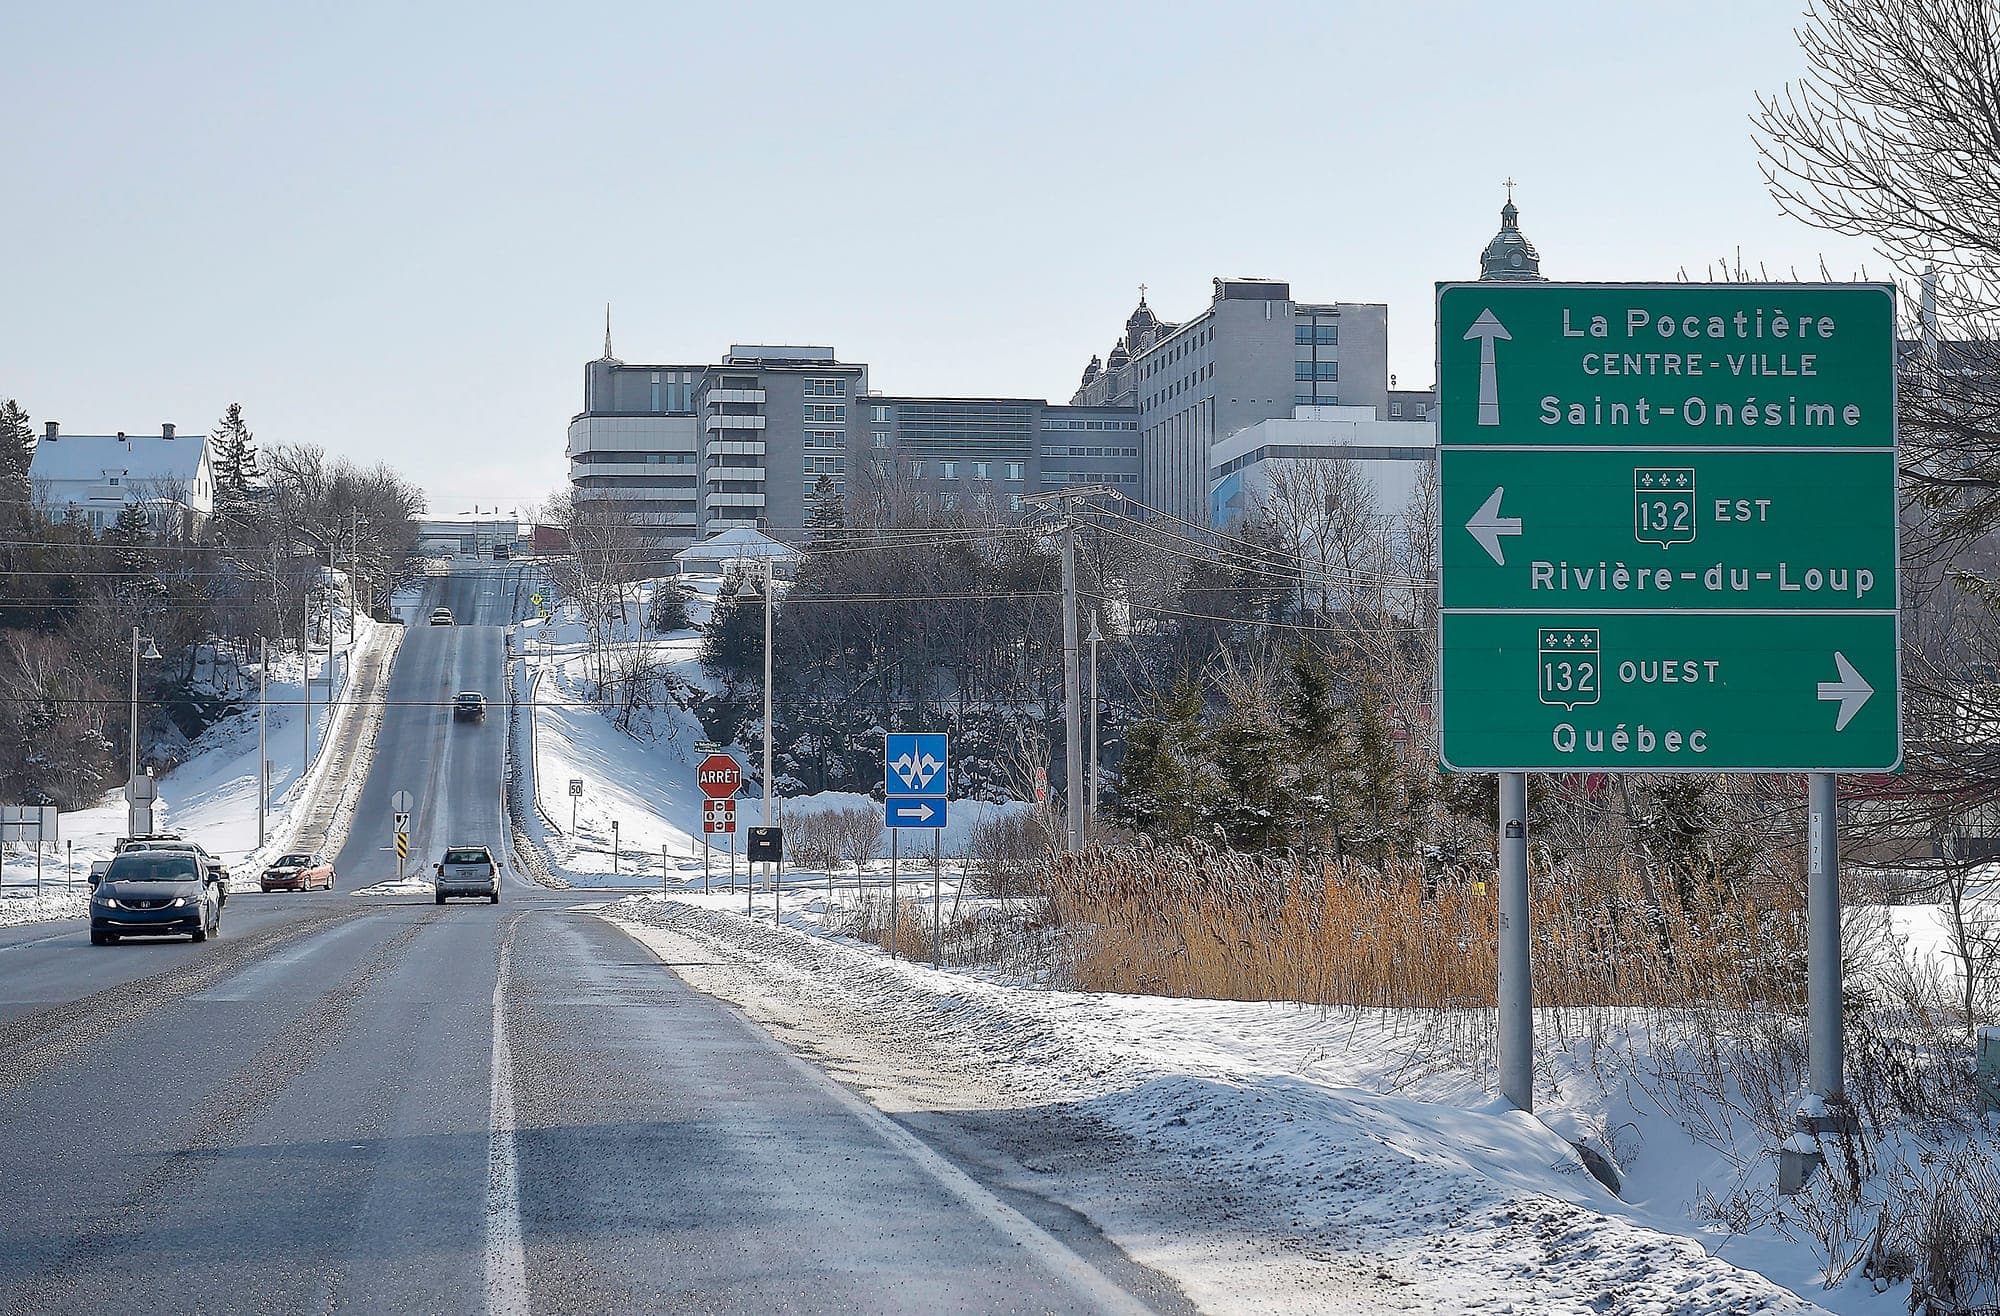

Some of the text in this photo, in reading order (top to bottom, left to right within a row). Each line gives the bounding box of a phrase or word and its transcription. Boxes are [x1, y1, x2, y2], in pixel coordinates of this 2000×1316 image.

[1563, 308, 1835, 338] La Pocatière
[1582, 353, 1817, 376] CENTRE-VILLE
[1539, 395, 1861, 426] Saint-Onésime
[1640, 499, 1771, 531] 132 EST
[1531, 561, 1874, 599] Rivière-du-Loup
[1544, 660, 1720, 692] 132 OUEST
[1552, 723, 1708, 753] Québec
[571, 784, 581, 794] 50
[699, 768, 740, 785] ARRÊT
